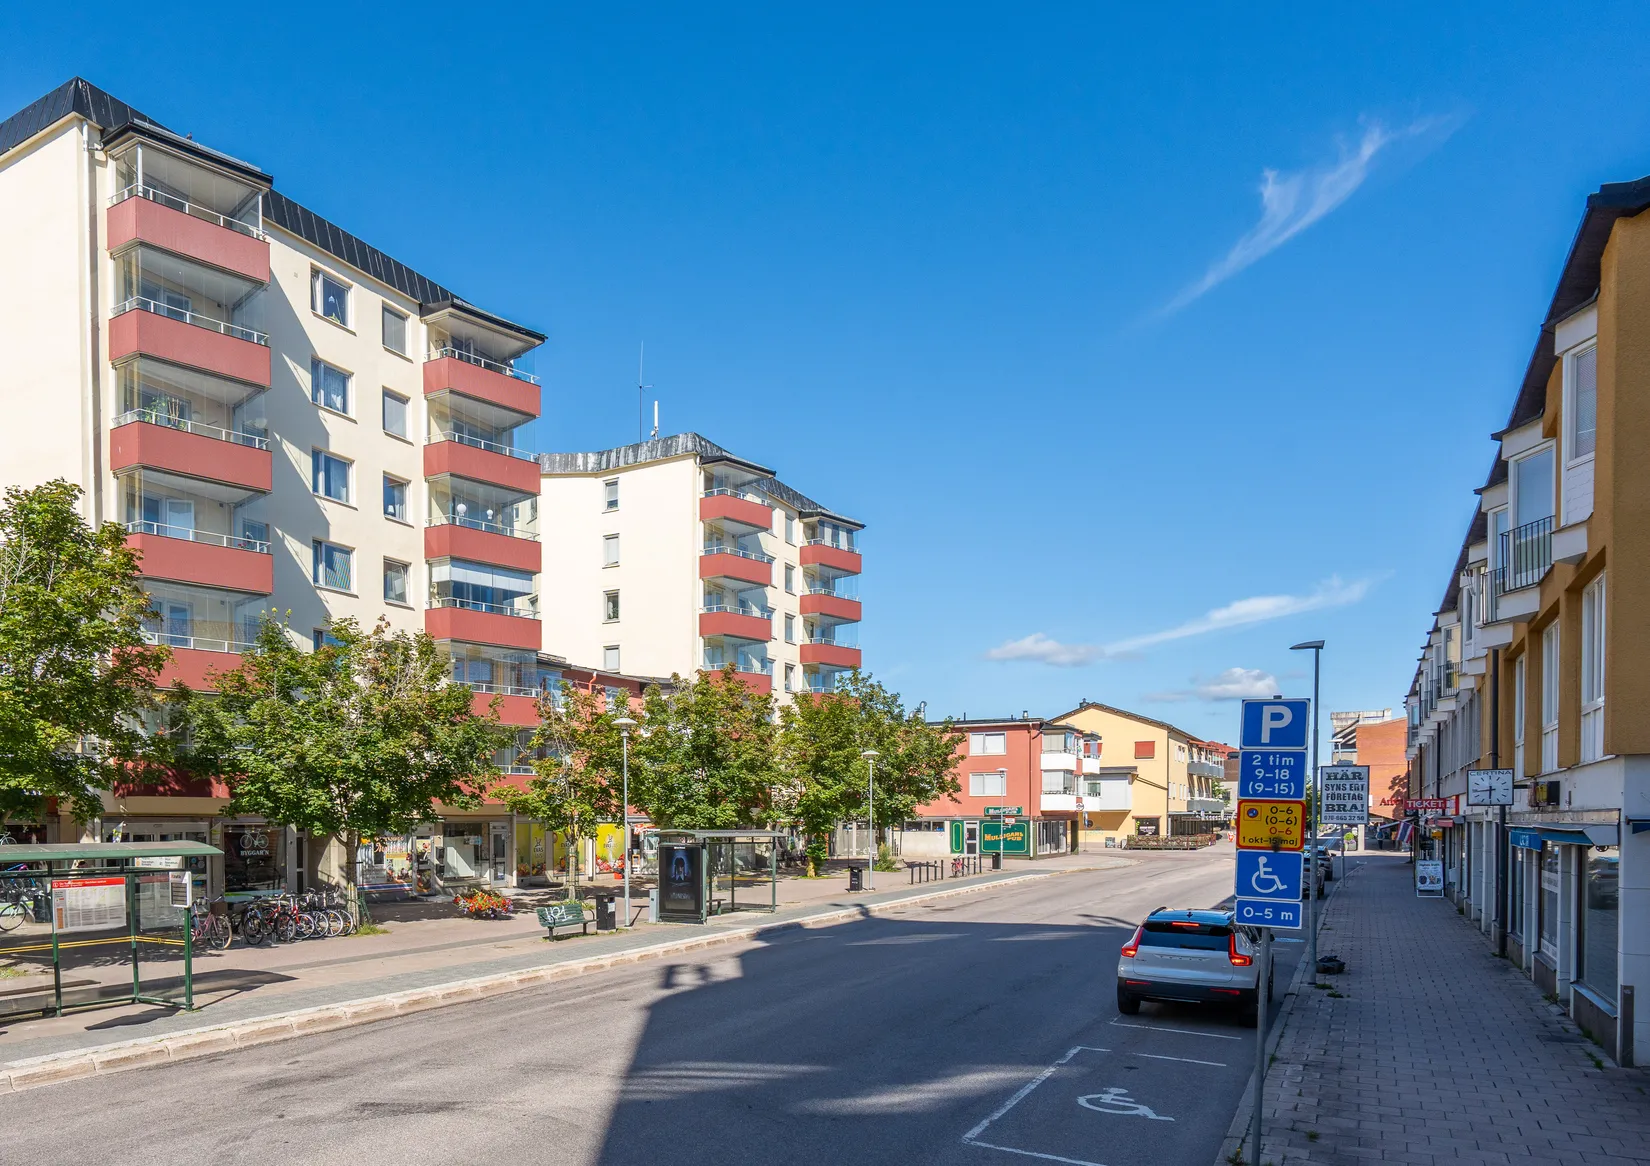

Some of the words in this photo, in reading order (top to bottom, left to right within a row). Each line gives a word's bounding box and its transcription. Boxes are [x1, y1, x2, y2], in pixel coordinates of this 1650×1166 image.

[1261, 705, 1293, 743] P
[1252, 754, 1261, 765] 2
[1269, 754, 1294, 766] tim
[1255, 768, 1290, 780] 9-18
[1326, 769, 1364, 781] HÄR
[1248, 781, 1295, 796] (9-15)
[1324, 783, 1347, 791] SYNS
[1349, 783, 1365, 791] ERT
[1326, 791, 1363, 801] FÖRETAG
[1325, 803, 1365, 813] BRA!
[1407, 800, 1443, 808] TICKET
[1270, 806, 1294, 815] 0-6
[1265, 815, 1298, 826] (0-6)
[1269, 826, 1293, 836] 0-6
[1280, 838, 1298, 847] maj
[1243, 906, 1273, 919] 0-5
[1281, 911, 1293, 921] m
